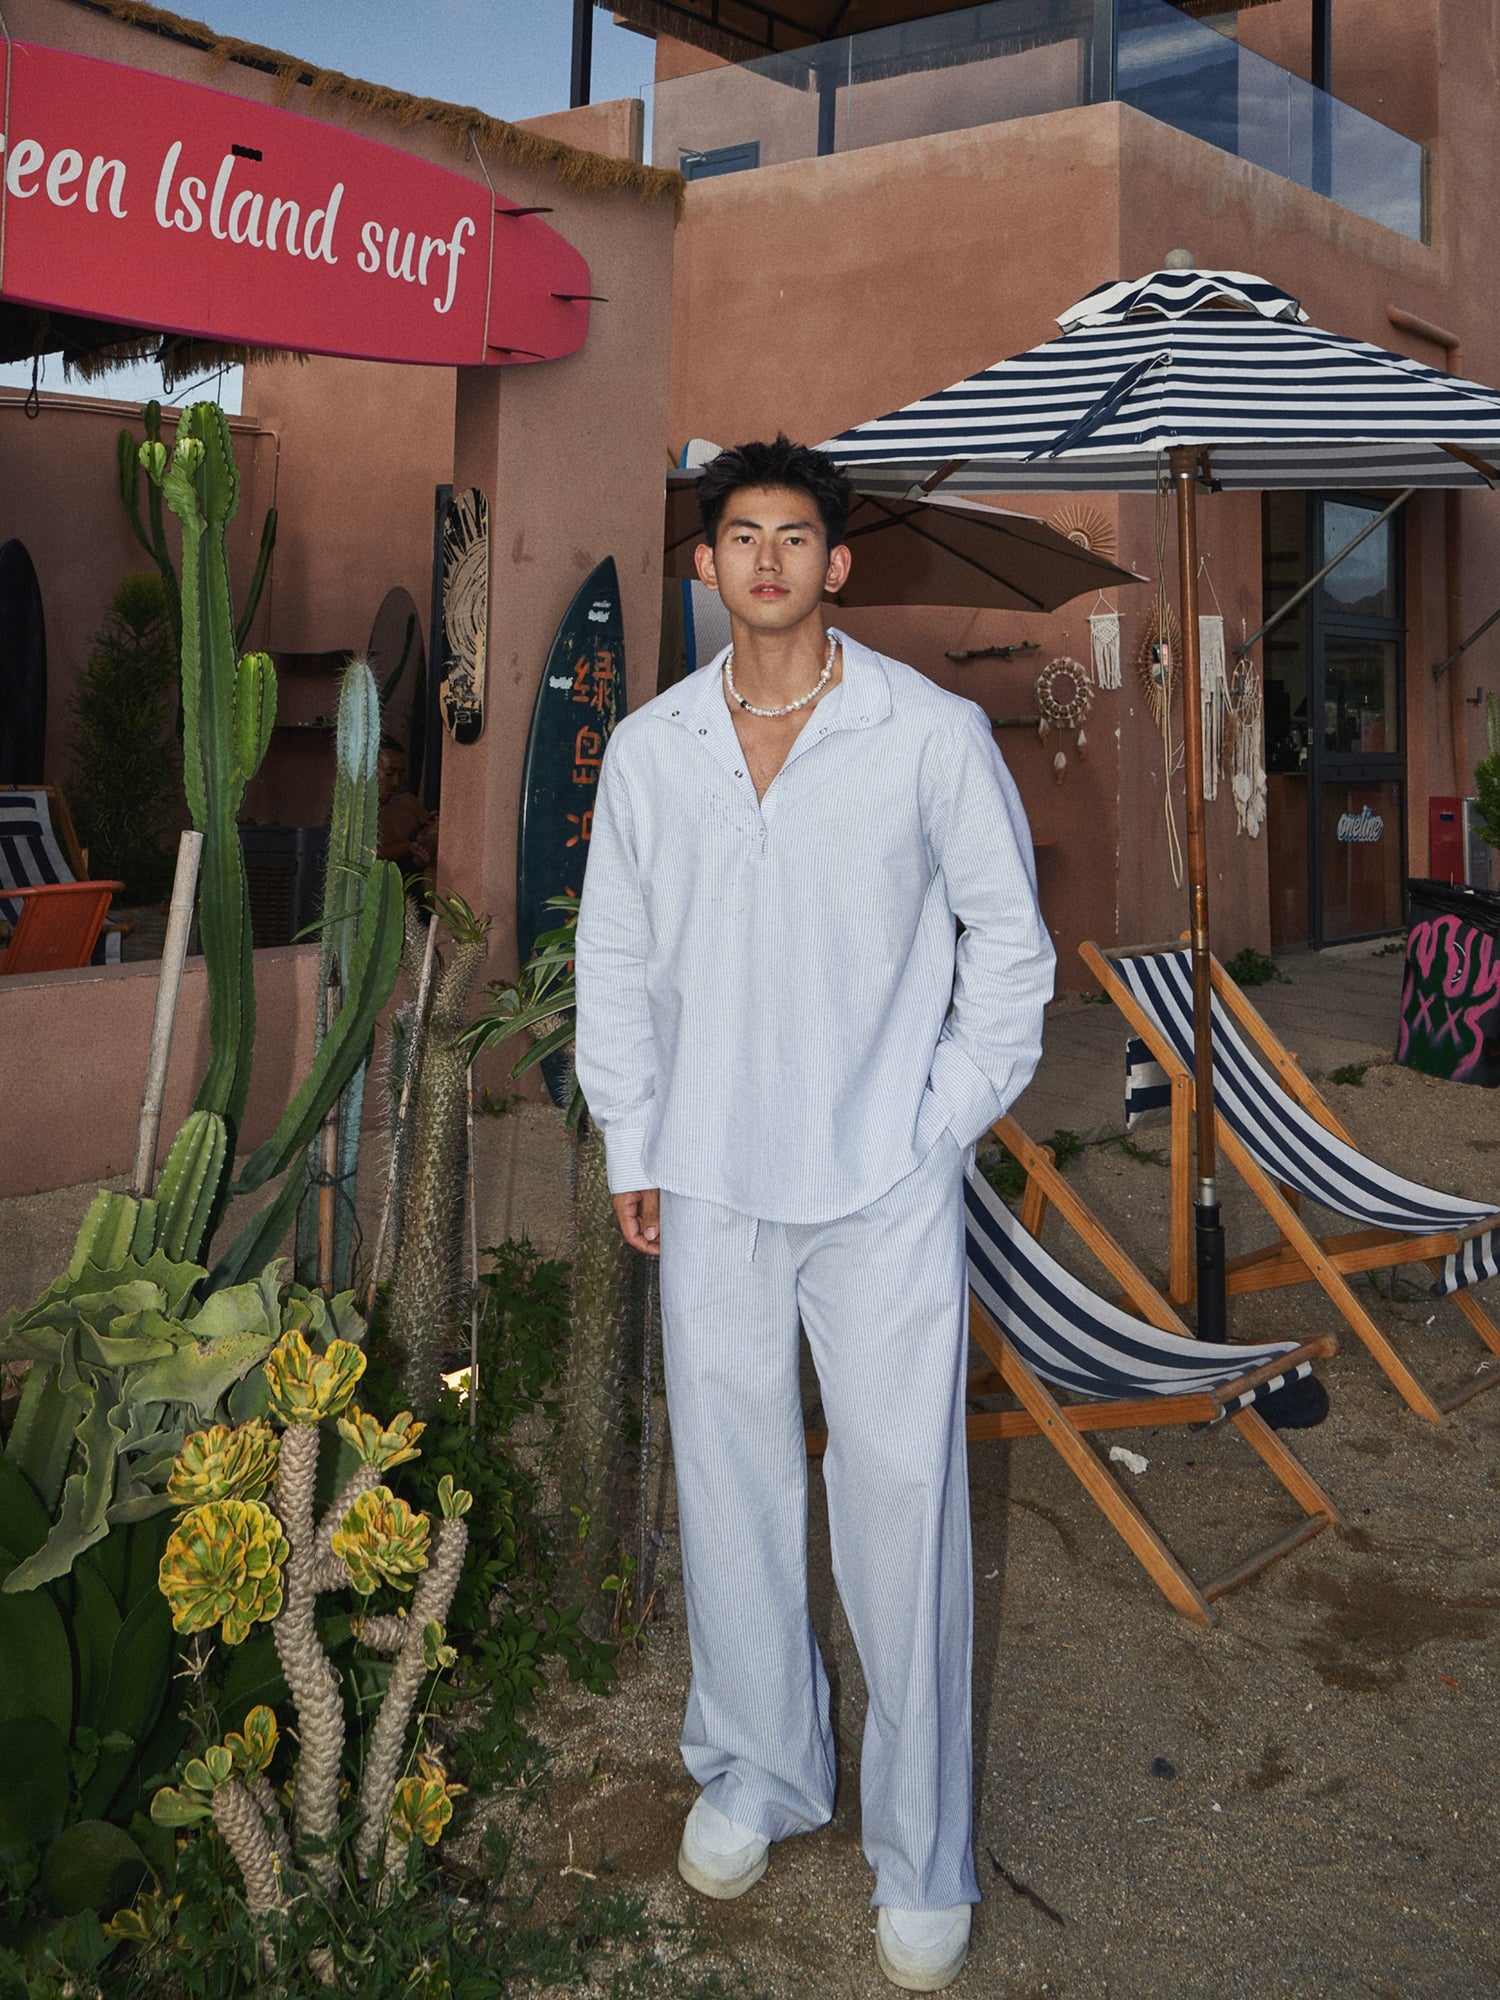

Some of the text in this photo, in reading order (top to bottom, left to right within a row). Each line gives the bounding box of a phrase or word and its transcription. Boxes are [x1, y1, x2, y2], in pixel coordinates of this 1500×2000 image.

[0, 133, 475, 313] een Island surf
